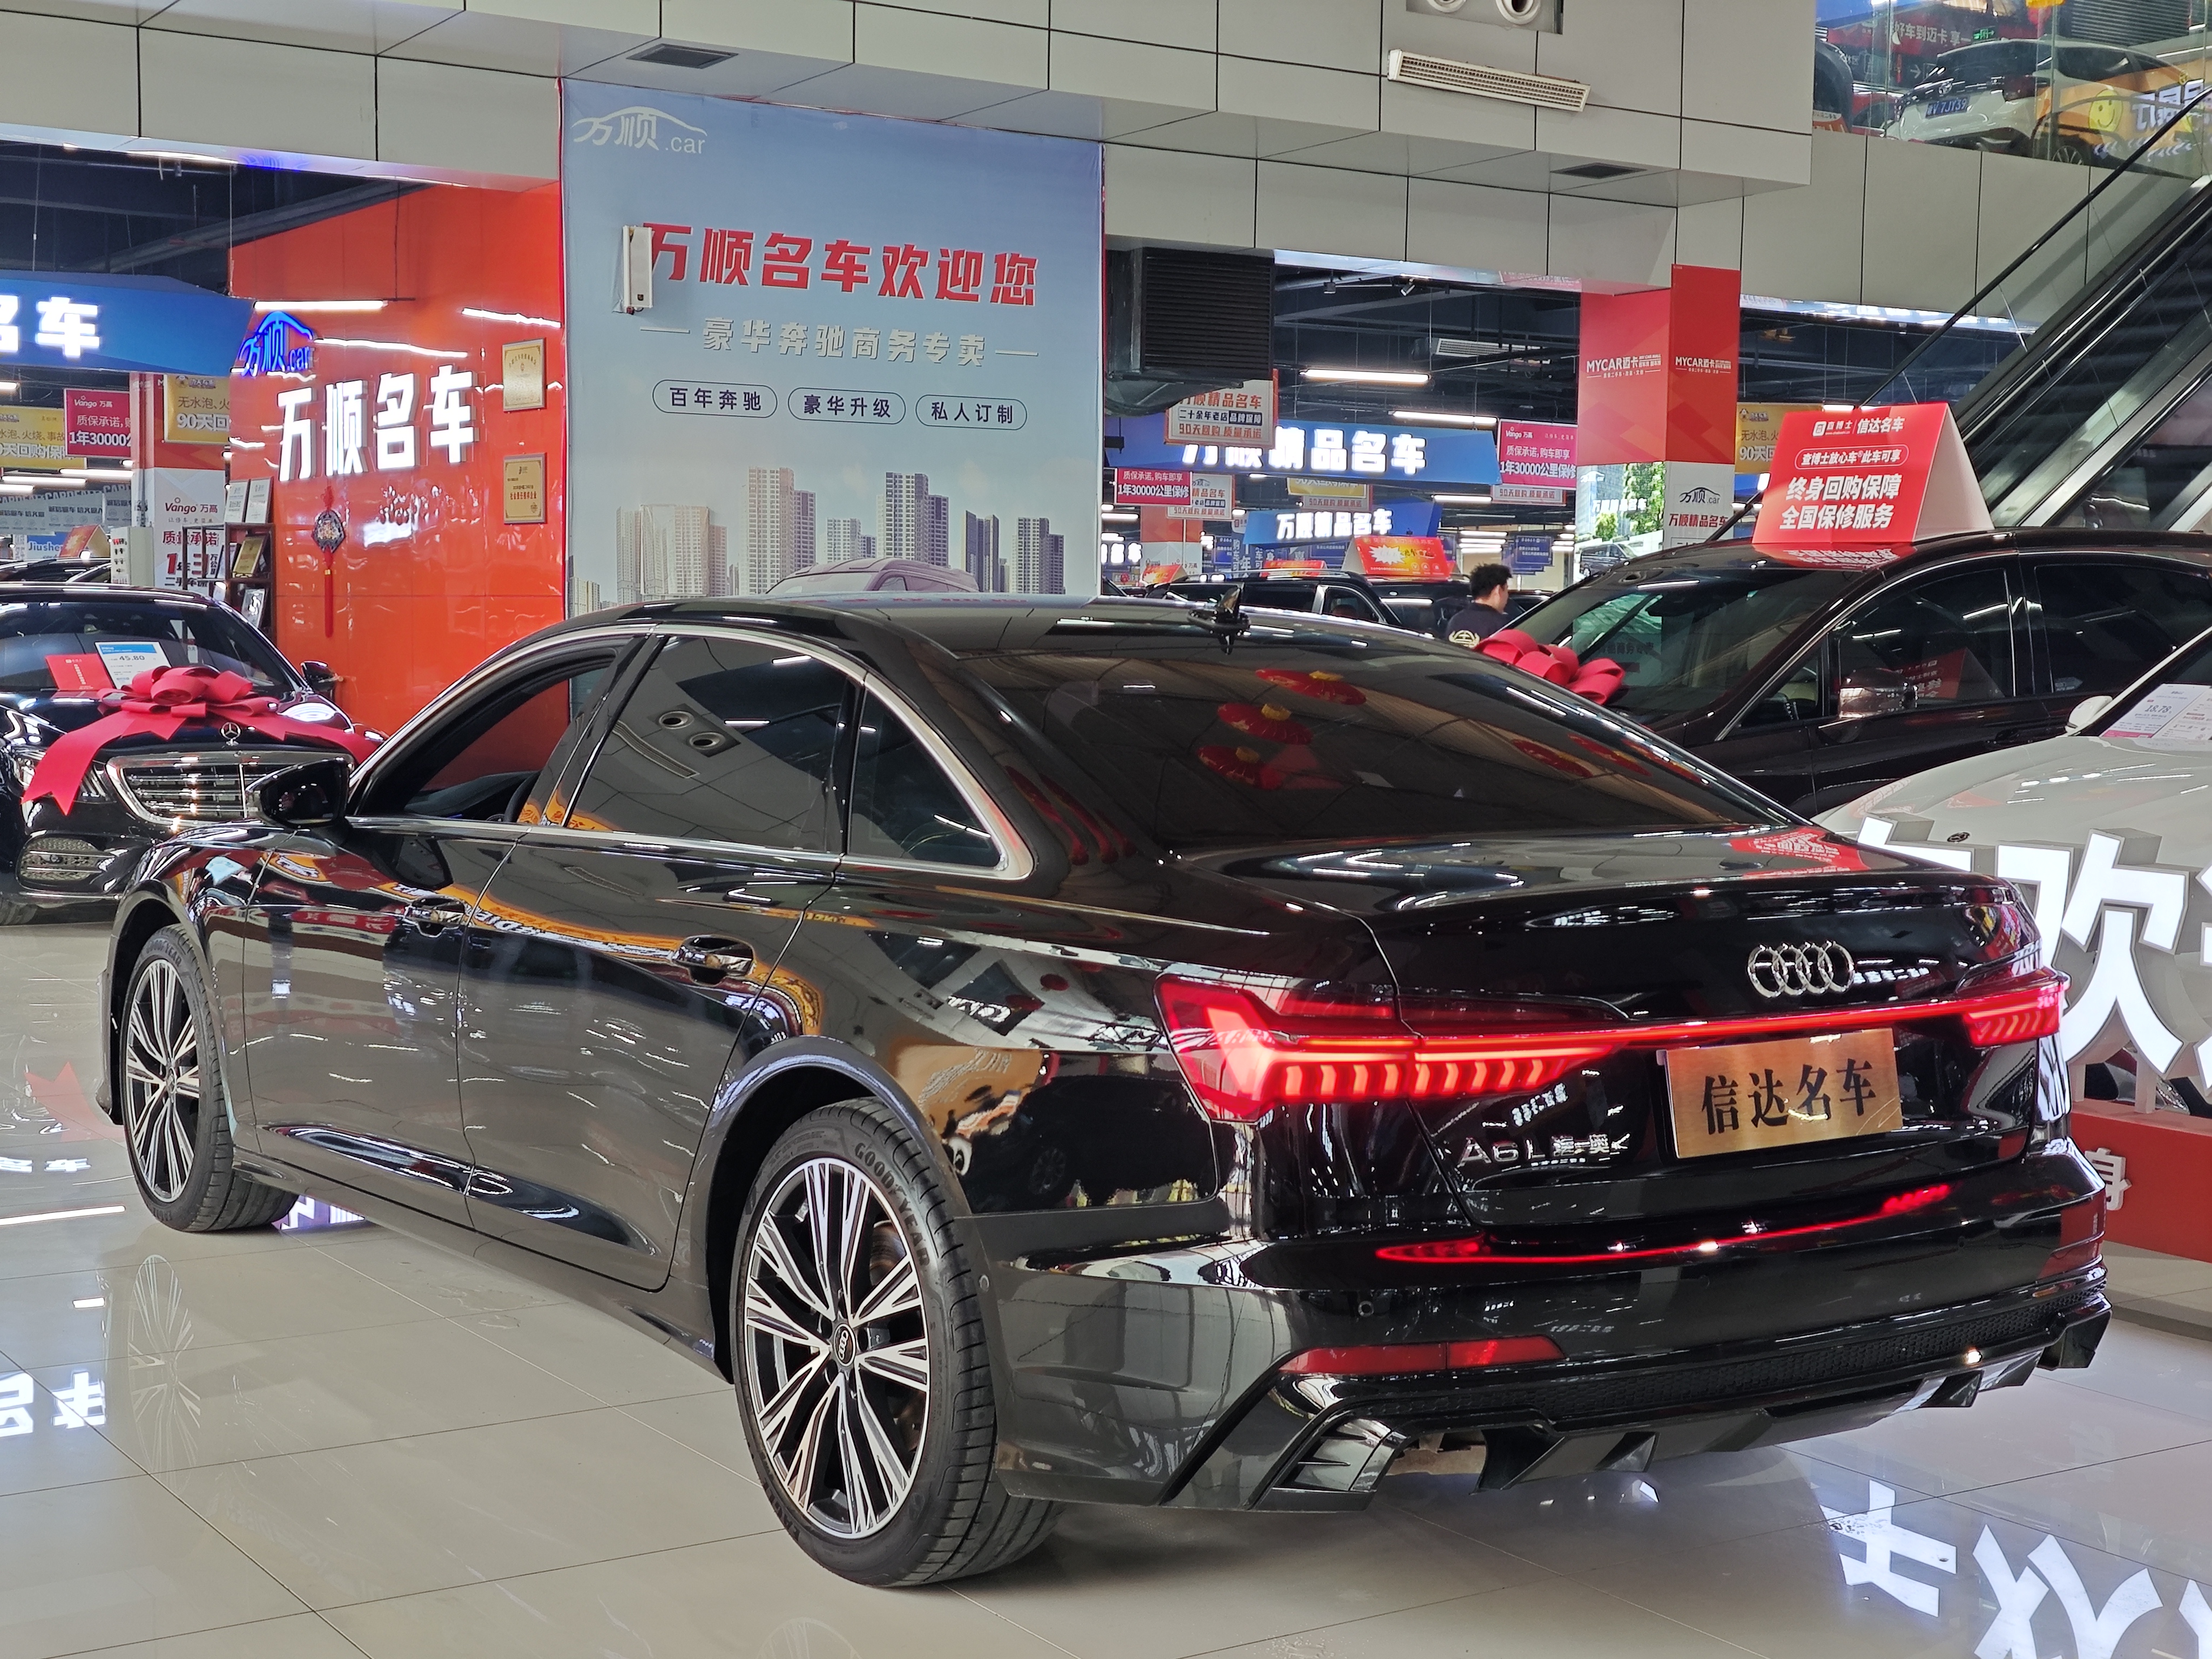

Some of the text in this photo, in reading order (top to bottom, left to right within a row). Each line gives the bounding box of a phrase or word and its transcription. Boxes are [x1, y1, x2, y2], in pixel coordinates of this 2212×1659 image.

[644, 222, 1038, 307] 万顺名车欢迎您
[703, 316, 986, 367] 豪华奔驰商务专卖
[670, 387, 1014, 424] 百年奔驰 豪华升级 私人订制
[1179, 410, 1228, 422] 二十余年老店
[278, 365, 475, 482] 万顺名车
[1179, 423, 1262, 439] 90天回购 质量承诺
[1857, 416, 1905, 434] 信达名车
[1500, 460, 1576, 479] 1年30000公里保修
[1118, 484, 1190, 498] 1年30000公里保修
[1785, 473, 1902, 502] 终身回购保障
[165, 502, 197, 515] Vango
[1669, 514, 1729, 528] 万顺精品名车
[1779, 503, 1894, 530] 全国保修服务
[1277, 509, 1393, 540] 万顺精品名车
[1701, 1057, 1877, 1136] 信达名车
